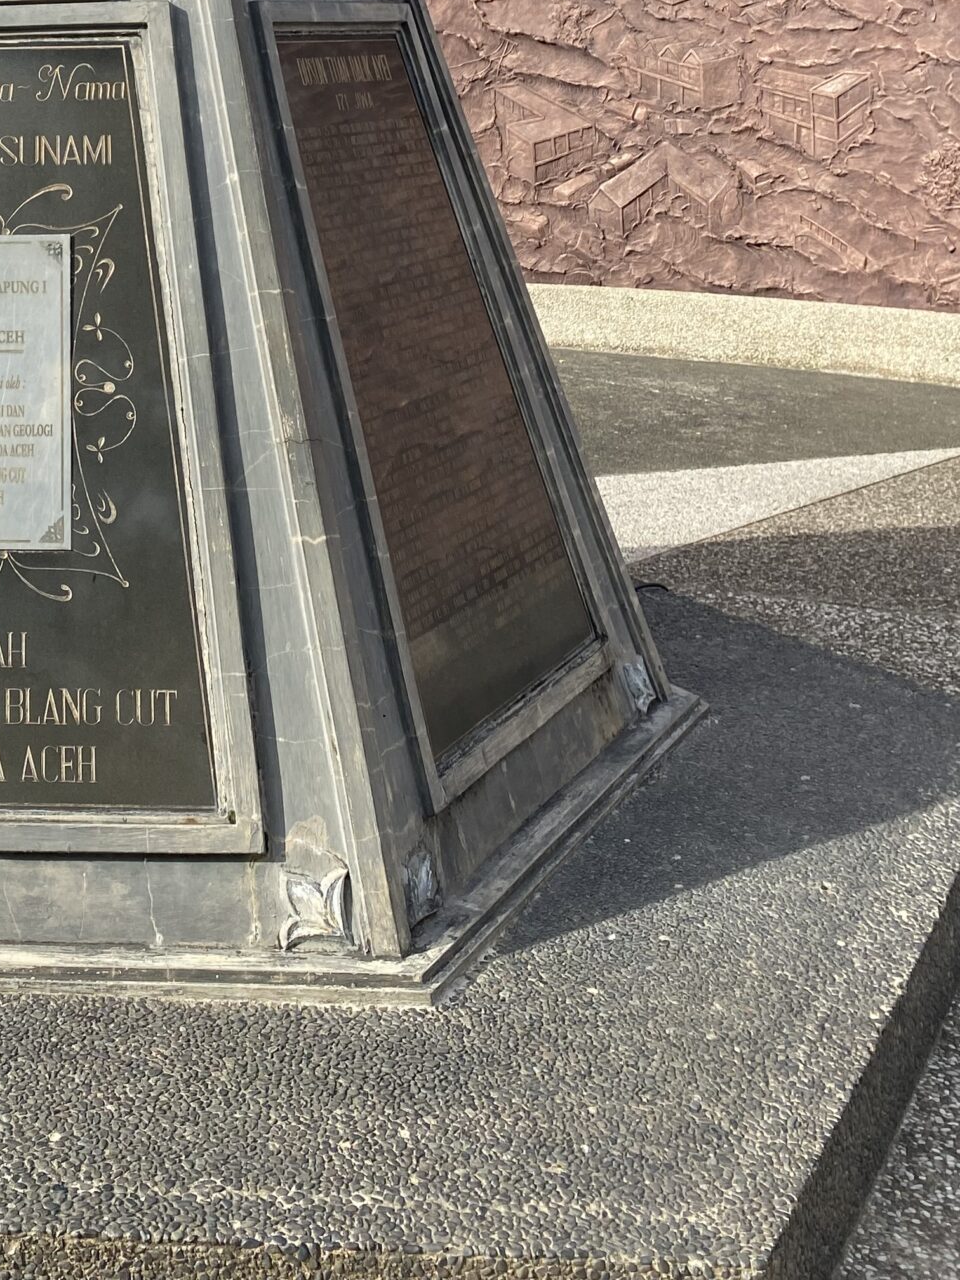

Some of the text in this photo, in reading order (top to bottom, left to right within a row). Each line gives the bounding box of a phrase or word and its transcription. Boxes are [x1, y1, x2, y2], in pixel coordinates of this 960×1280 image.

[35, 63, 126, 102] Nama
[335, 93, 350, 112] 171
[6, 404, 25, 418] DAN
[13, 424, 53, 437] GEOLOGI
[9, 443, 35, 457] ACEH
[4, 687, 102, 726] BLANG
[115, 688, 178, 726] CUT
[21, 744, 97, 784] ACEH
